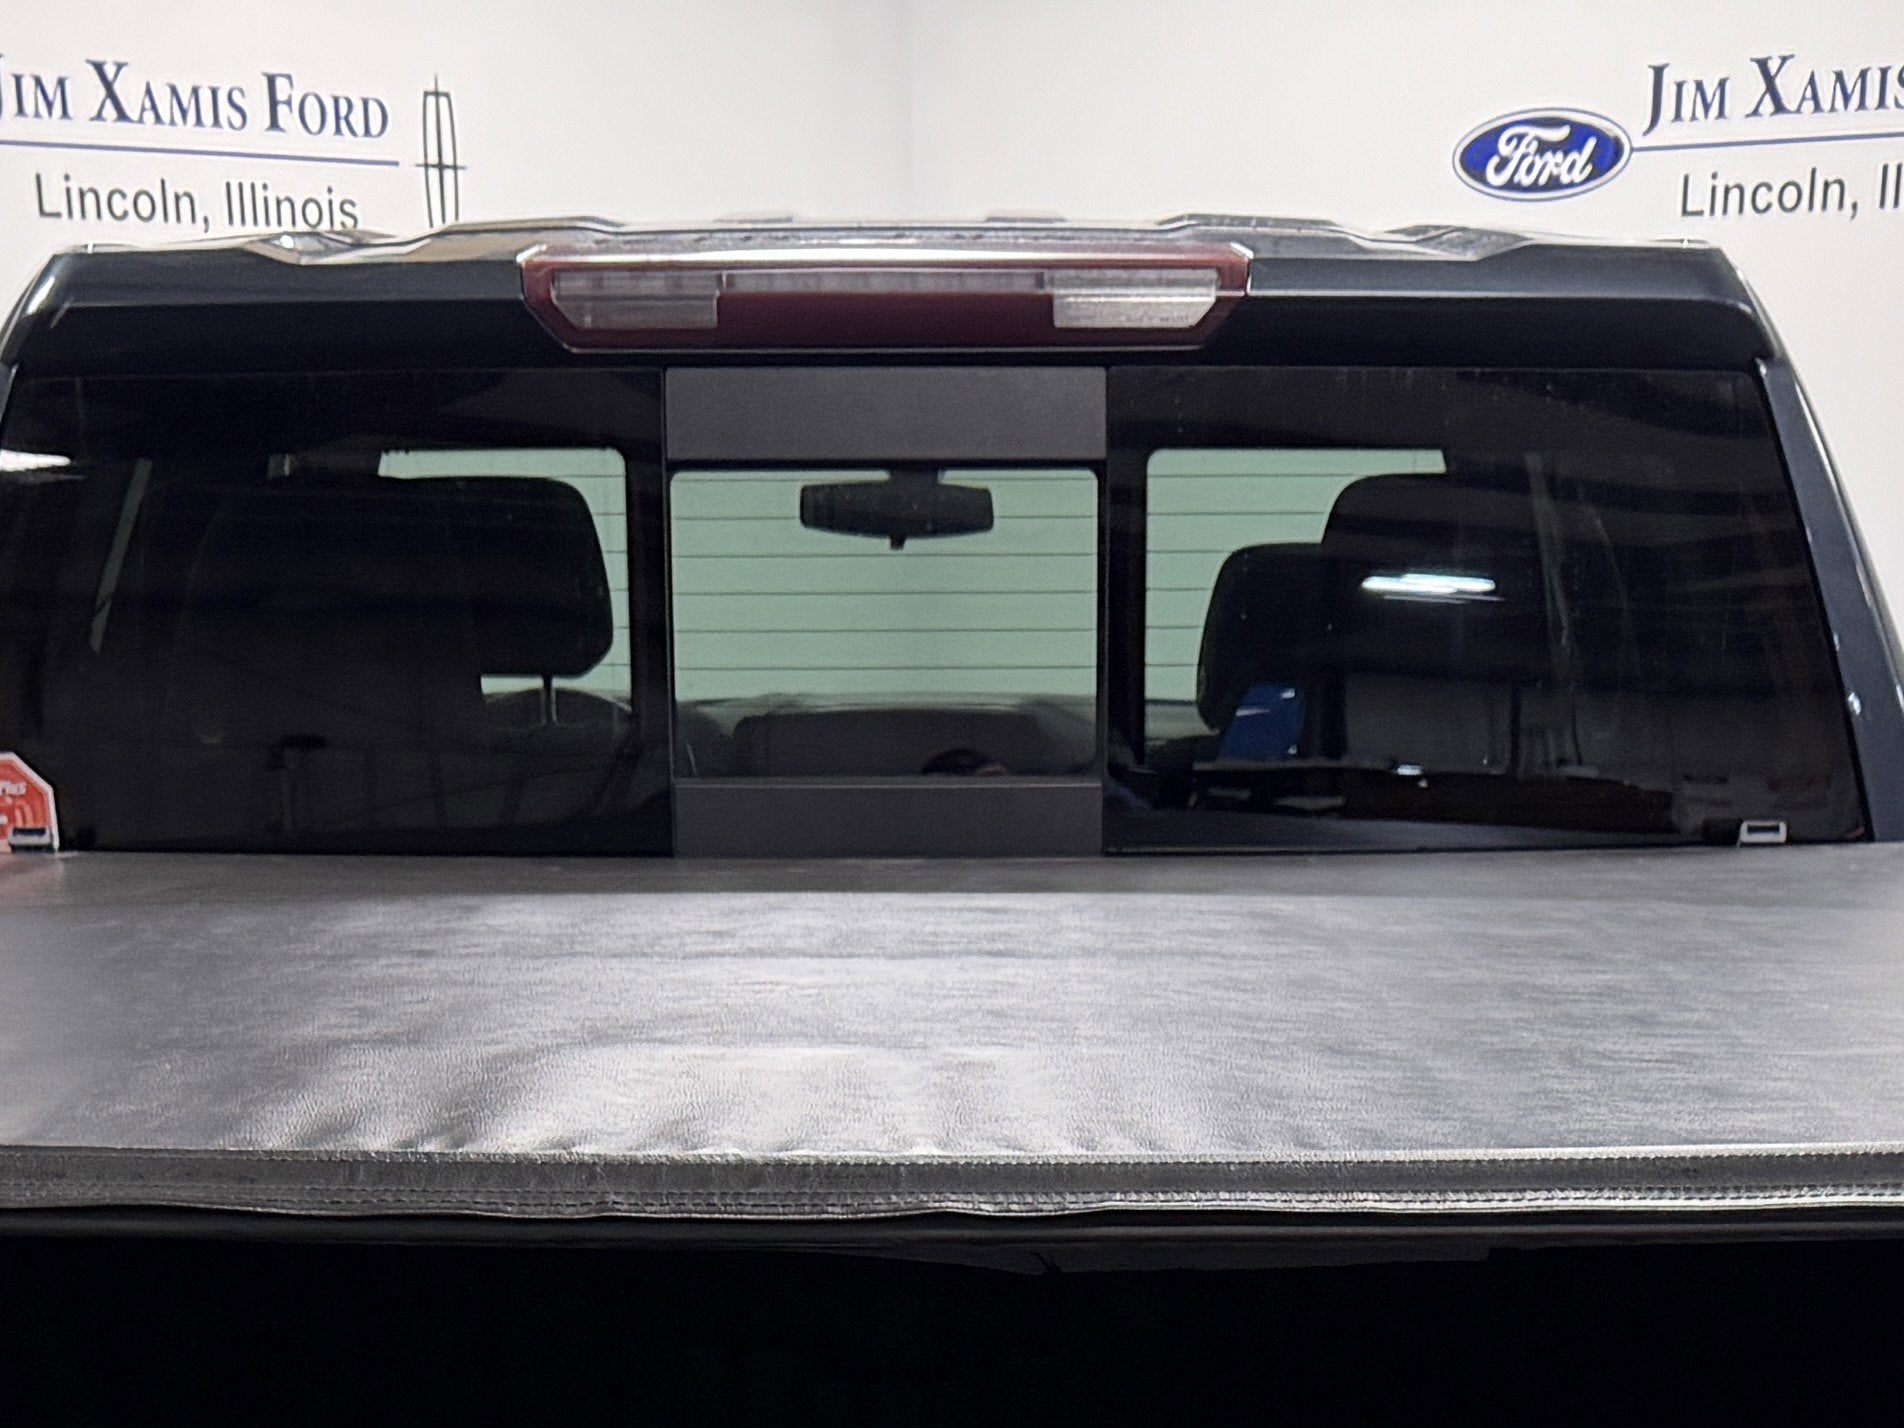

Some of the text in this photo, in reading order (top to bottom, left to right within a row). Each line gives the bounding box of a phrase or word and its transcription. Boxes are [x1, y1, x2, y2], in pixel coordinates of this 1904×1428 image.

[84, 58, 249, 131] XAMIS
[261, 71, 389, 138] FORD
[1642, 63, 1729, 136] JIM
[1486, 124, 1594, 188] Ford
[35, 173, 359, 233] Lincoln, Illinois
[1680, 167, 1858, 219] Lincoln,
